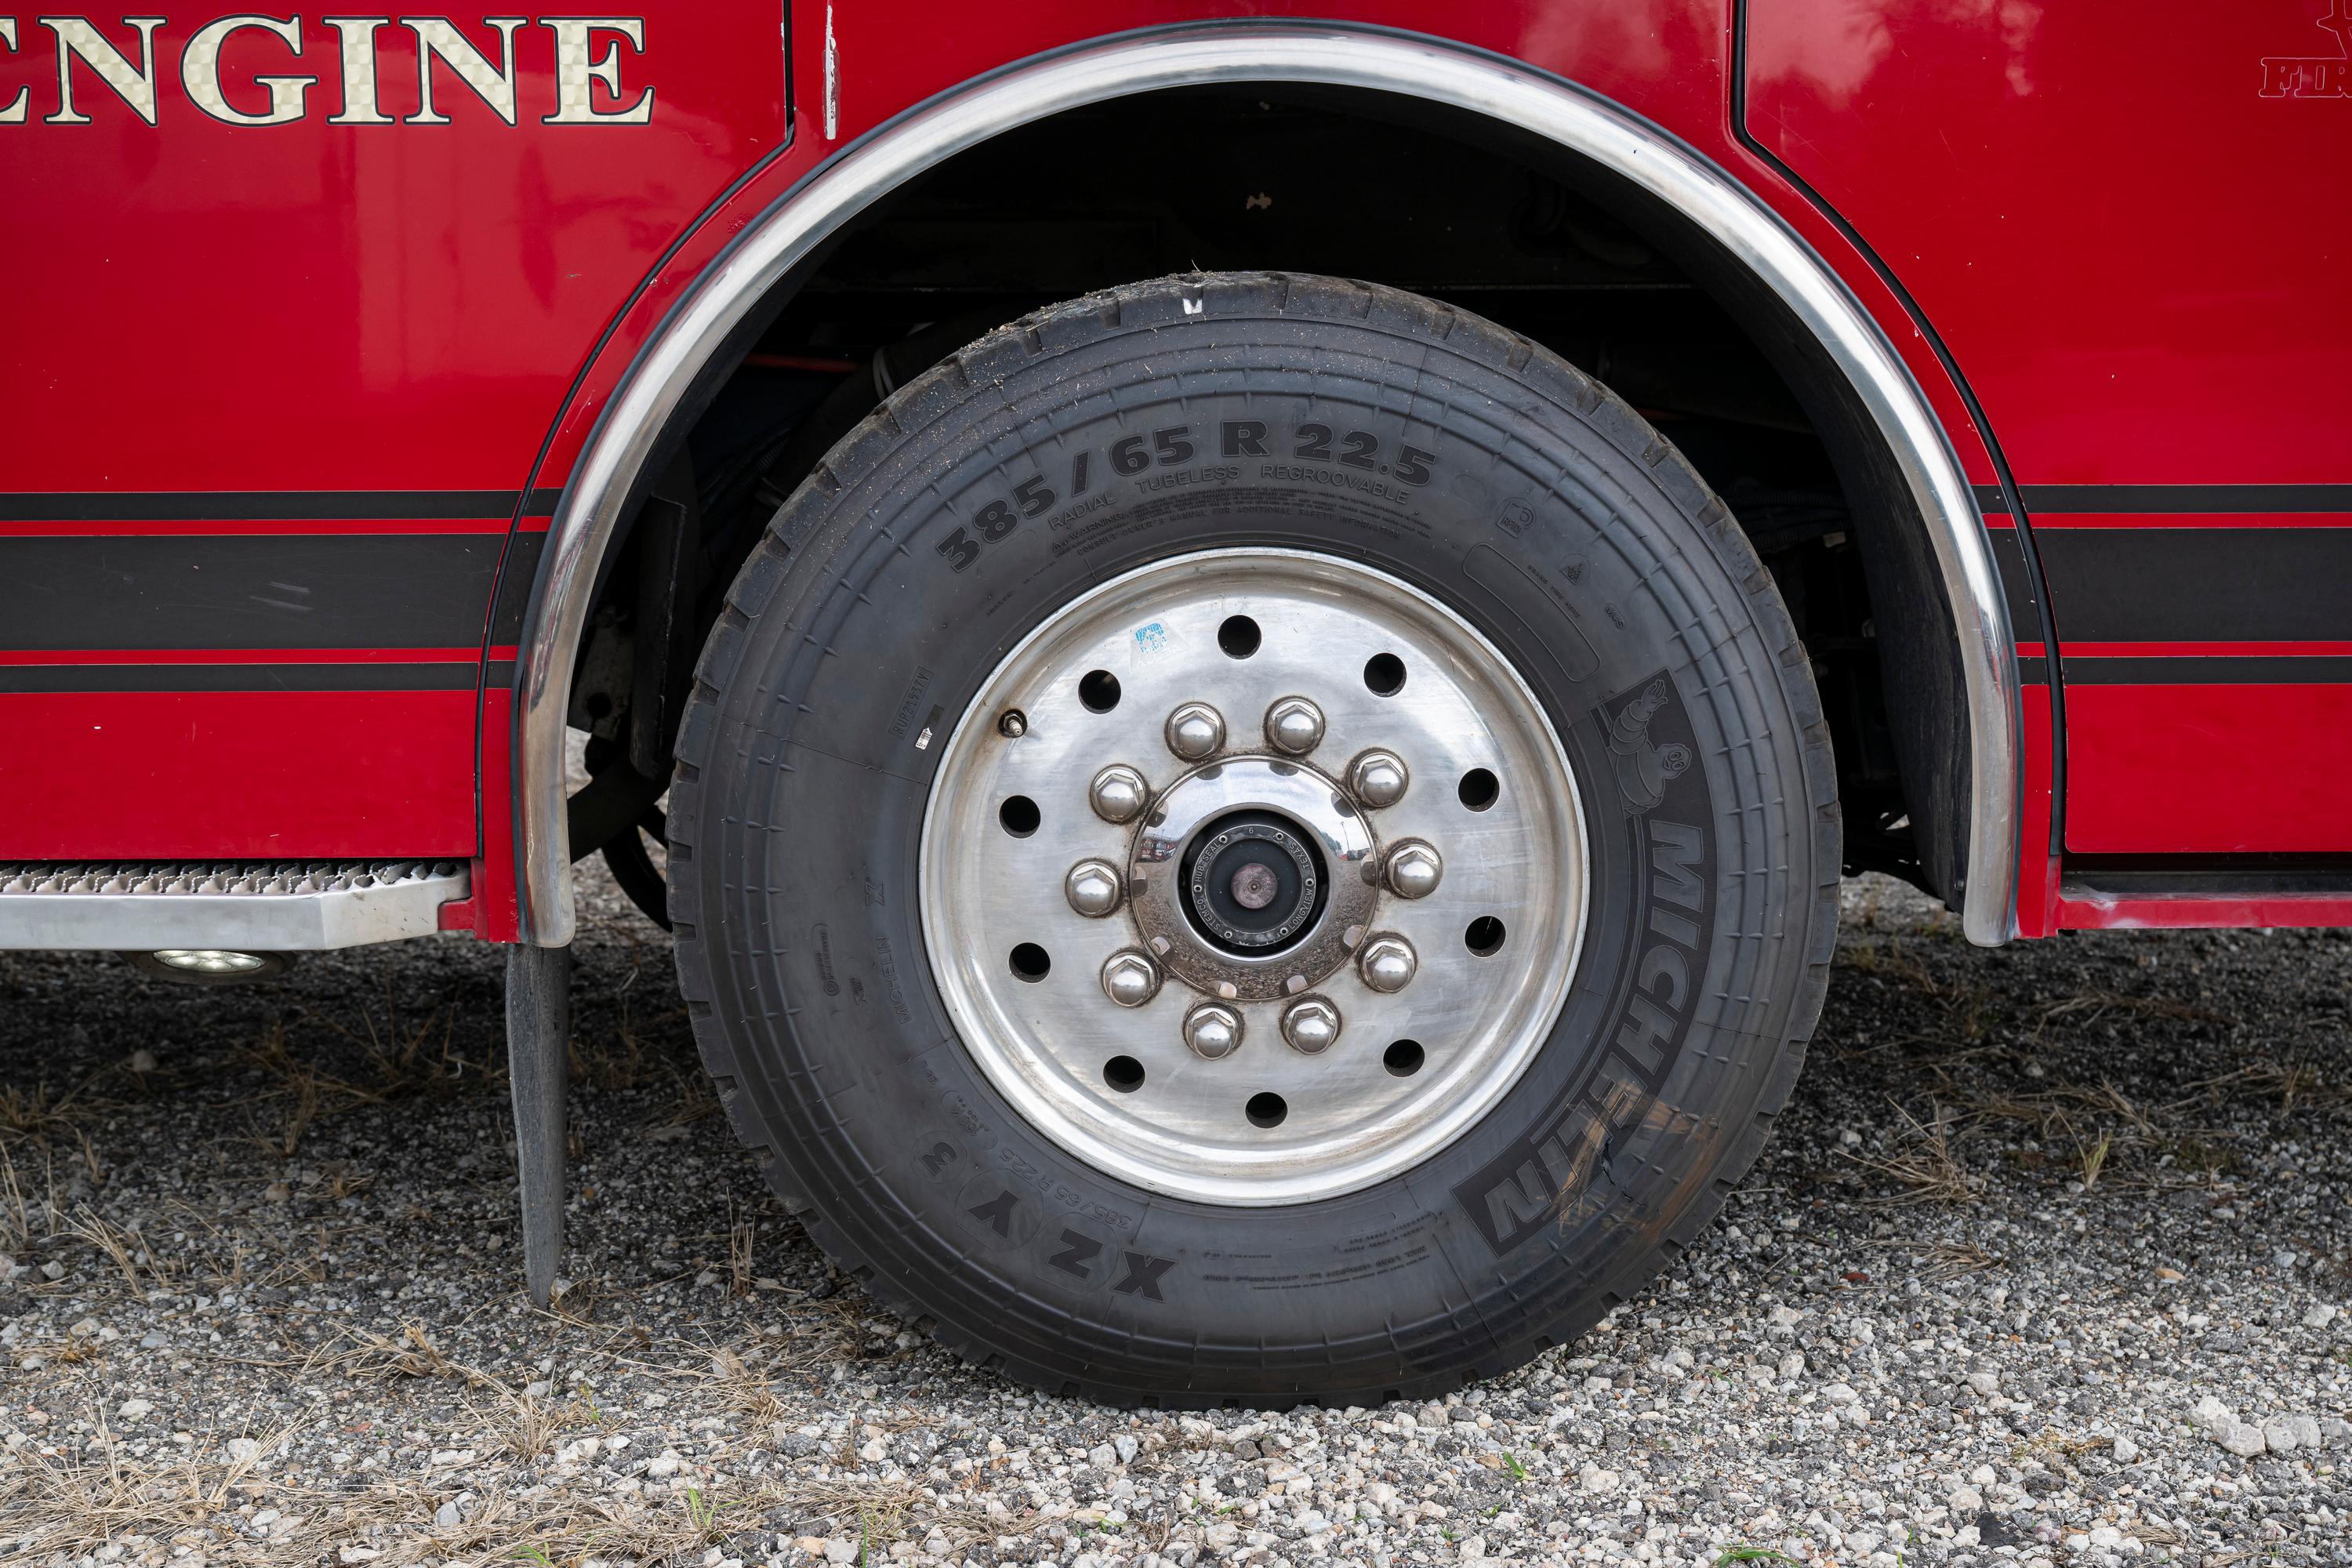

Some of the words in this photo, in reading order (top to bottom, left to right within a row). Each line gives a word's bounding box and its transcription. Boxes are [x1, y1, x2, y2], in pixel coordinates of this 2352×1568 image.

[0, 14, 655, 126] NGINE
[1220, 419, 1270, 457] R
[1294, 422, 1437, 486] 22.5
[1047, 494, 1119, 532] RADIAL
[1137, 464, 1241, 494] TUBELESS
[1261, 463, 1410, 505] REGROOVABLE
[1068, 512, 1123, 542] WARNING
[1076, 532, 1120, 557] CONSULT
[1211, 505, 1230, 516] FOR
[1290, 842, 1312, 869] TEXAS
[1196, 898, 1221, 931] STEMCO
[1287, 888, 1314, 931] LONGVIEW
[877, 935, 912, 1024] MICHELIN
[1484, 819, 1704, 1242] MICHELIN
[999, 1147, 1037, 1182] 22.5
[1036, 1173, 1056, 1192] R
